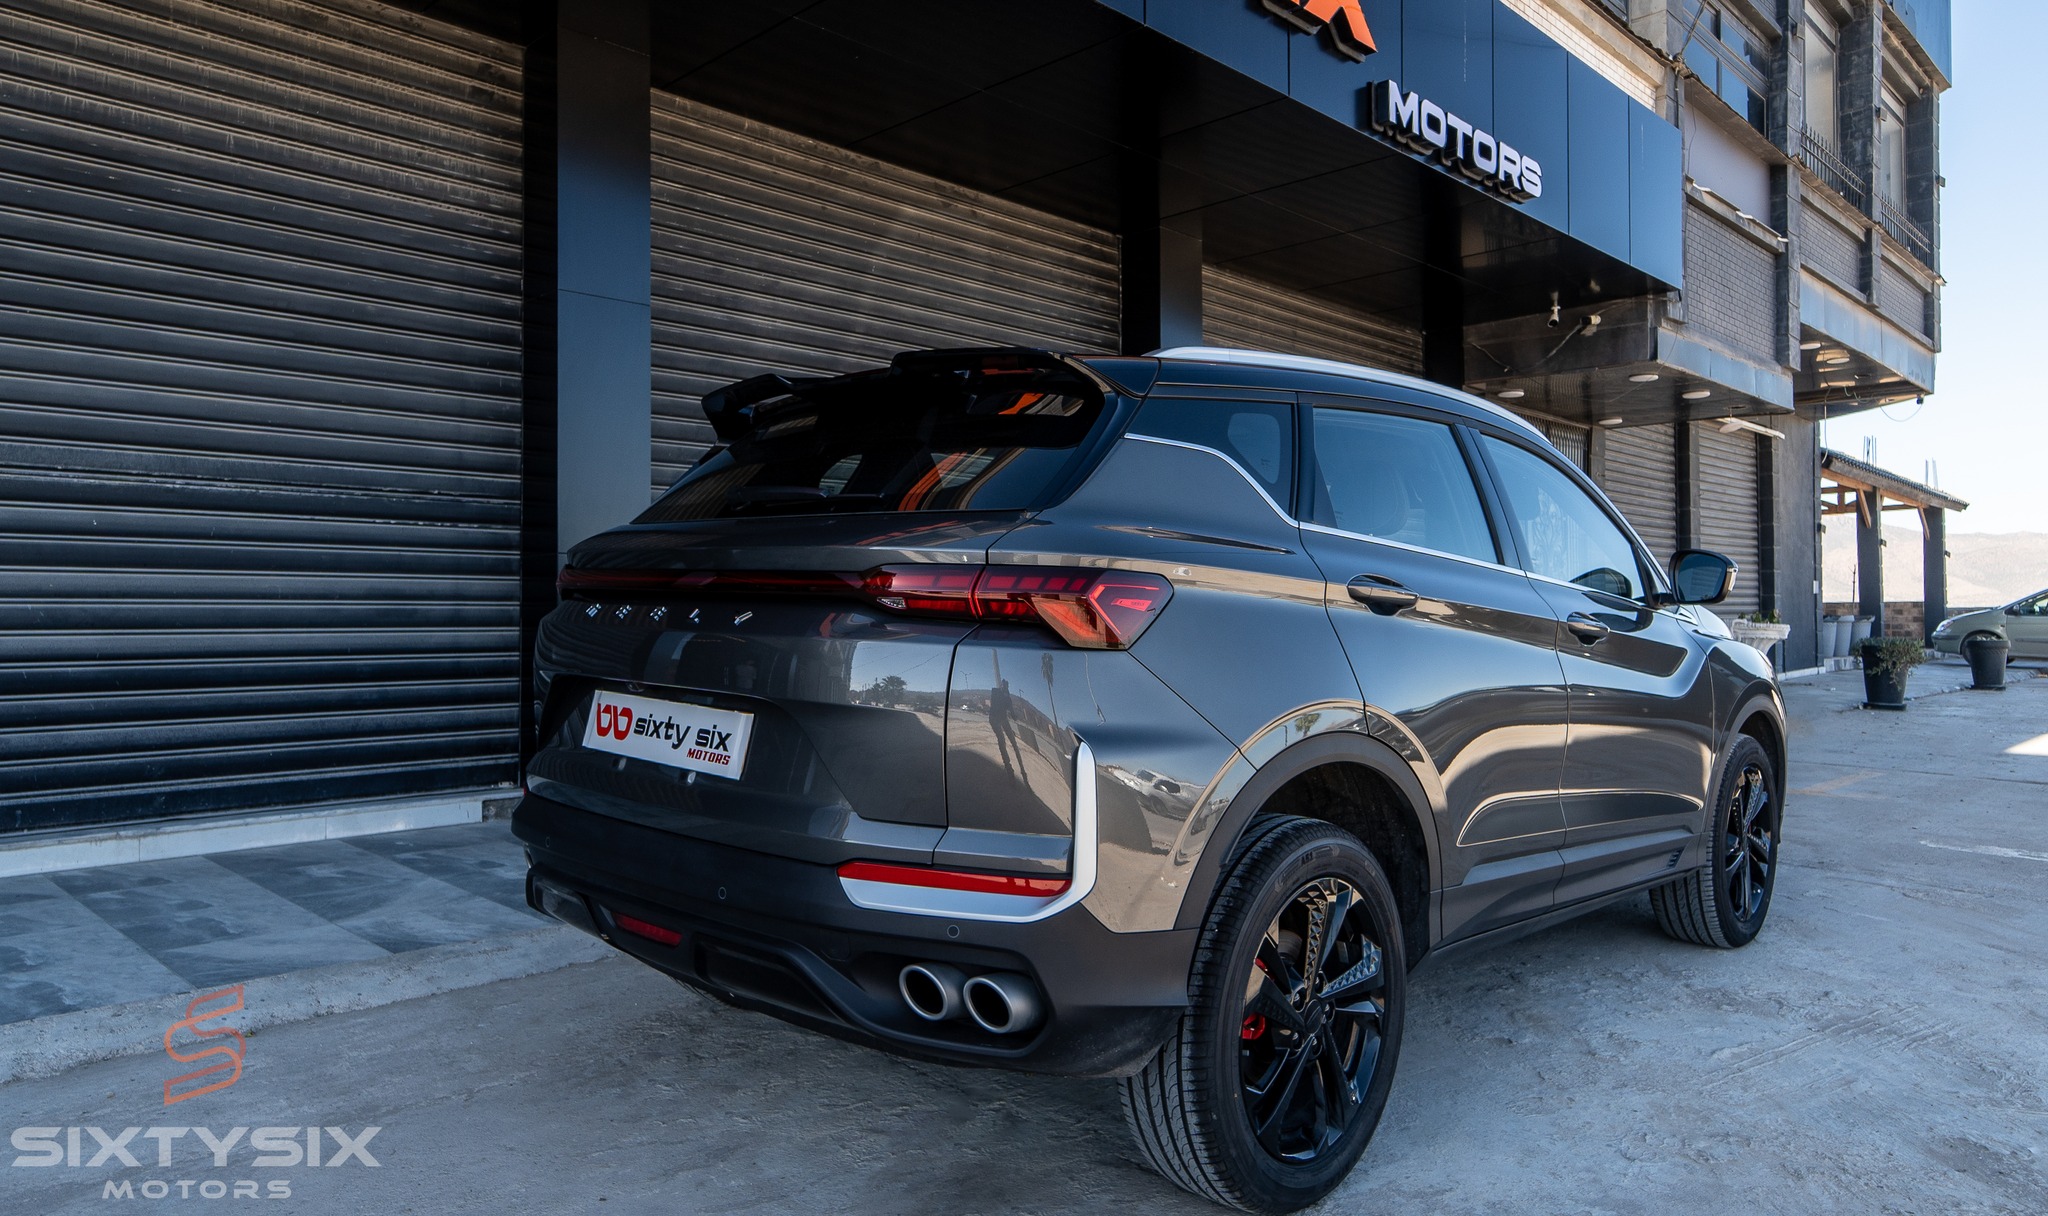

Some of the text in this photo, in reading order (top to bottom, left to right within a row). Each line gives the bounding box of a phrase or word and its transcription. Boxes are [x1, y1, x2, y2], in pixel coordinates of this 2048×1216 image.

[1387, 78, 1543, 199] MOTORS
[633, 713, 692, 750] sixty
[694, 724, 733, 753] six
[686, 747, 731, 766] MOTORS
